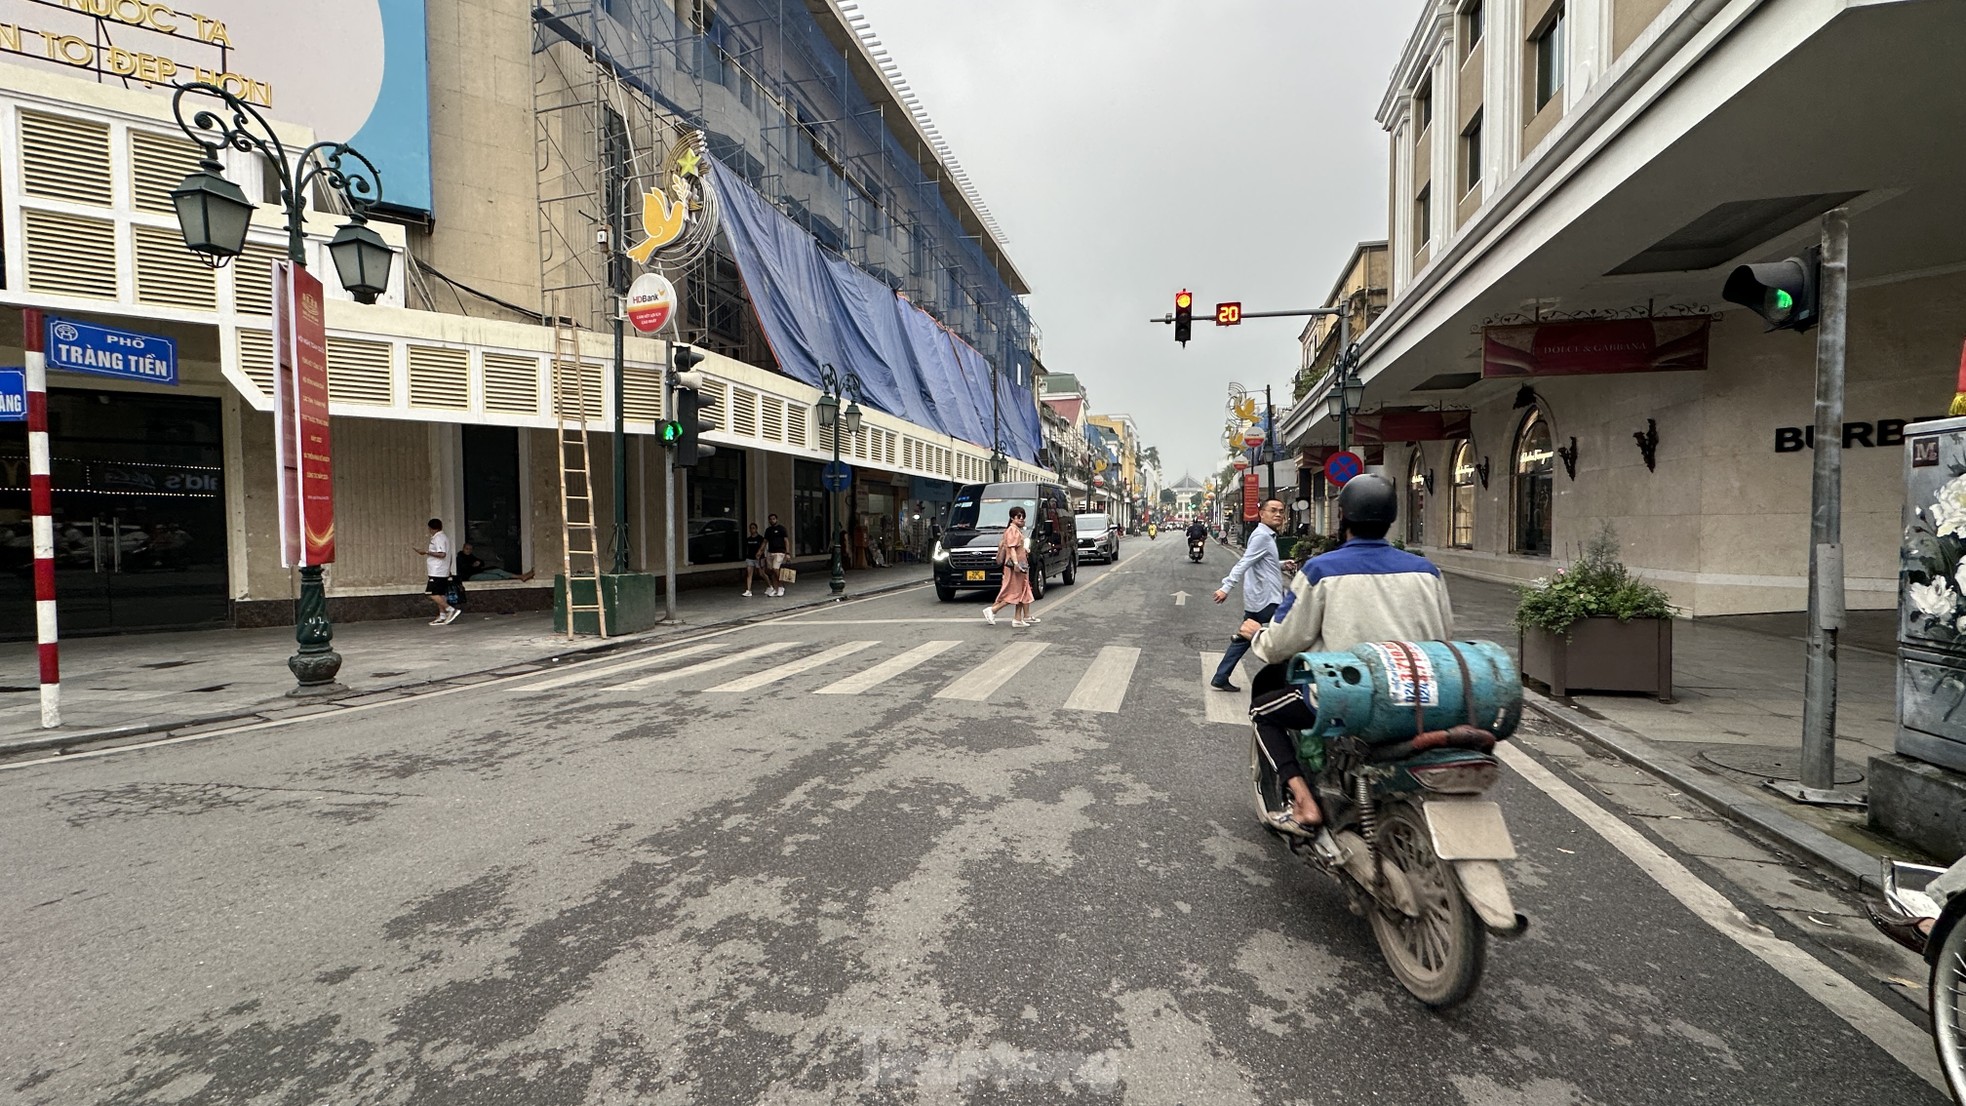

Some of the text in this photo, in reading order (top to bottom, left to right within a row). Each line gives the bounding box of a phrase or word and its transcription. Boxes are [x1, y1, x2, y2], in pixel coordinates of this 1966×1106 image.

[192, 13, 231, 46] TA
[40, 31, 93, 66] TO
[107, 46, 177, 89] ĐẸP
[633, 293, 659, 304] HDBank
[1219, 306, 1239, 322] 20
[106, 334, 146, 349] PHỐ
[1593, 342, 1648, 353] GABBANA
[58, 343, 168, 377] TRÀNG TIỀN
